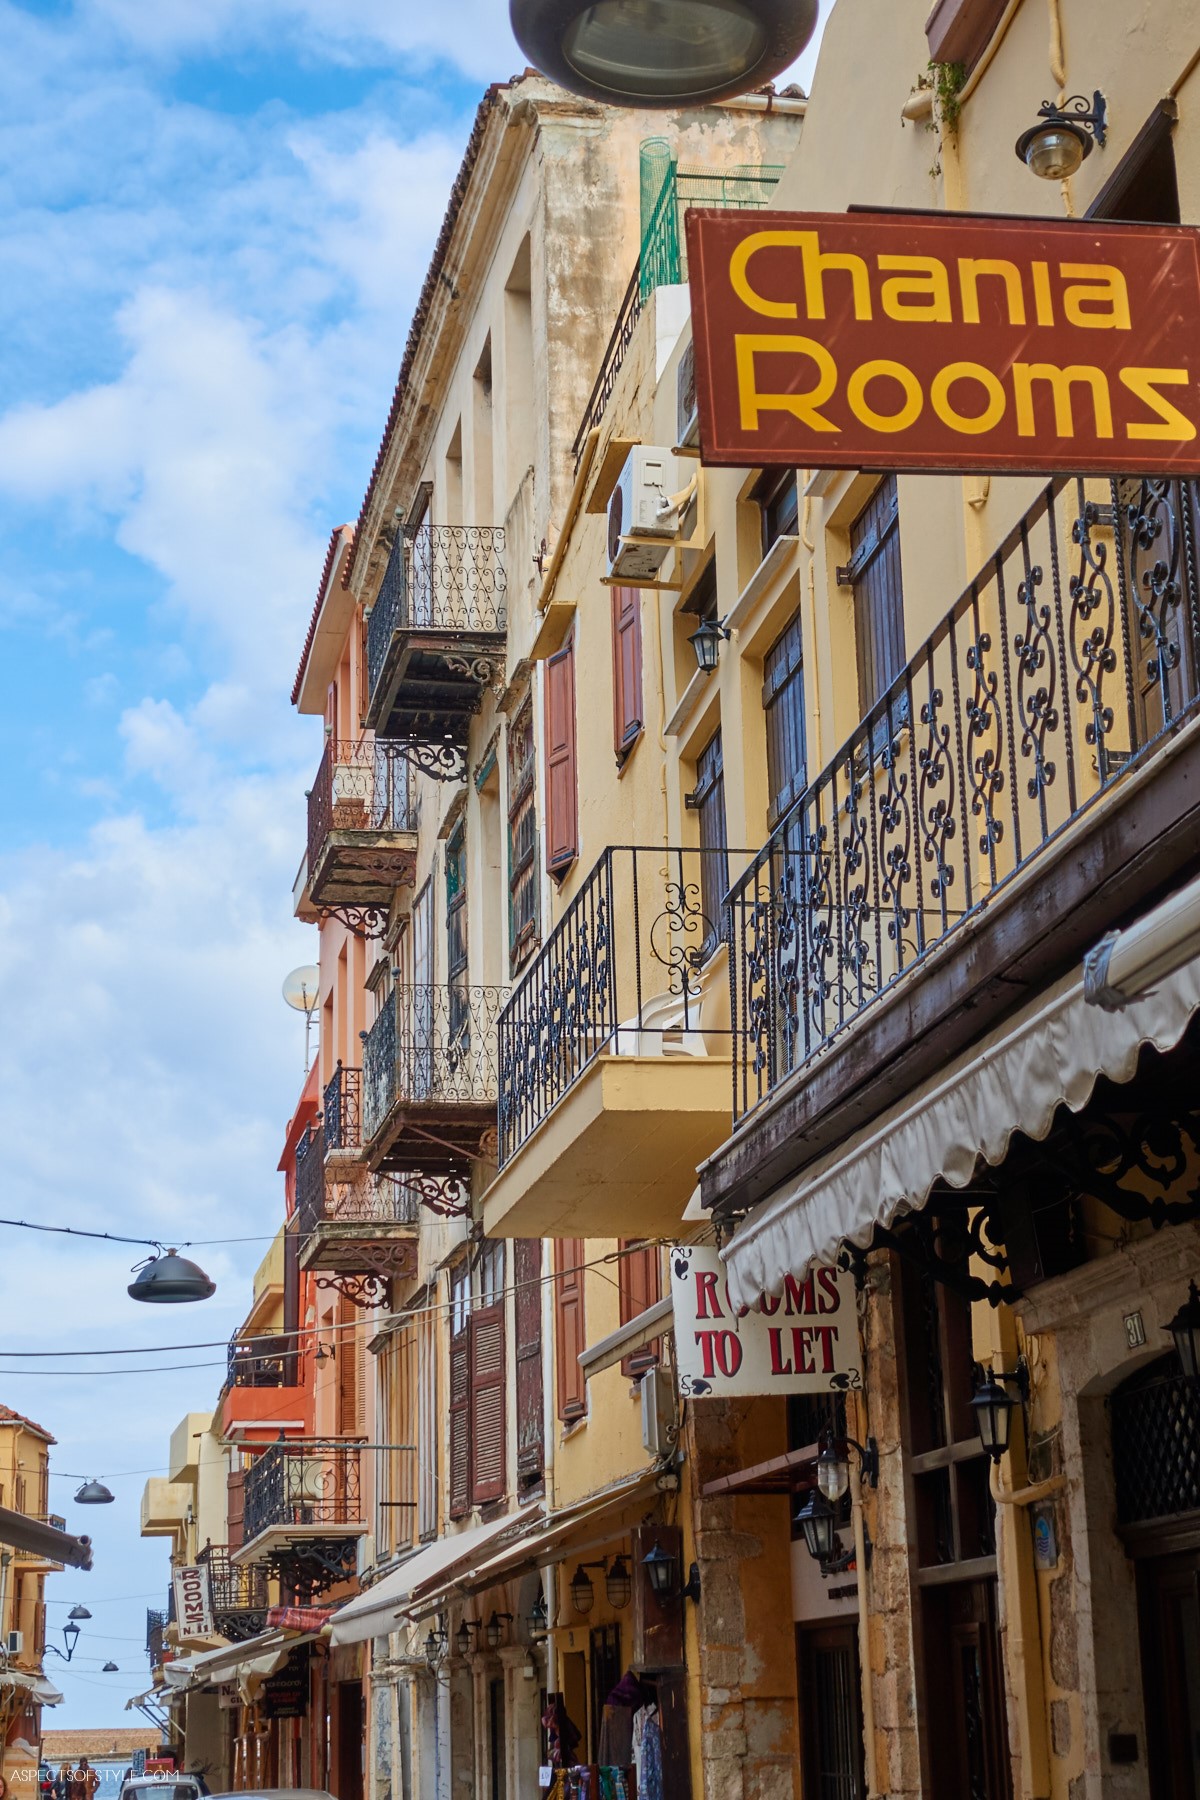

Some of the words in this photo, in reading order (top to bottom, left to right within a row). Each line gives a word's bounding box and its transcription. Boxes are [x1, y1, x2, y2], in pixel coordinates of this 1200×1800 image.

[730, 230, 1132, 330] Chania
[735, 334, 1198, 441] Rooms
[695, 1267, 840, 1319] RMS
[694, 1330, 743, 1378] TO
[768, 1326, 839, 1375] LET
[1126, 1316, 1141, 1343] 31
[182, 1569, 204, 1624] ROOMS
